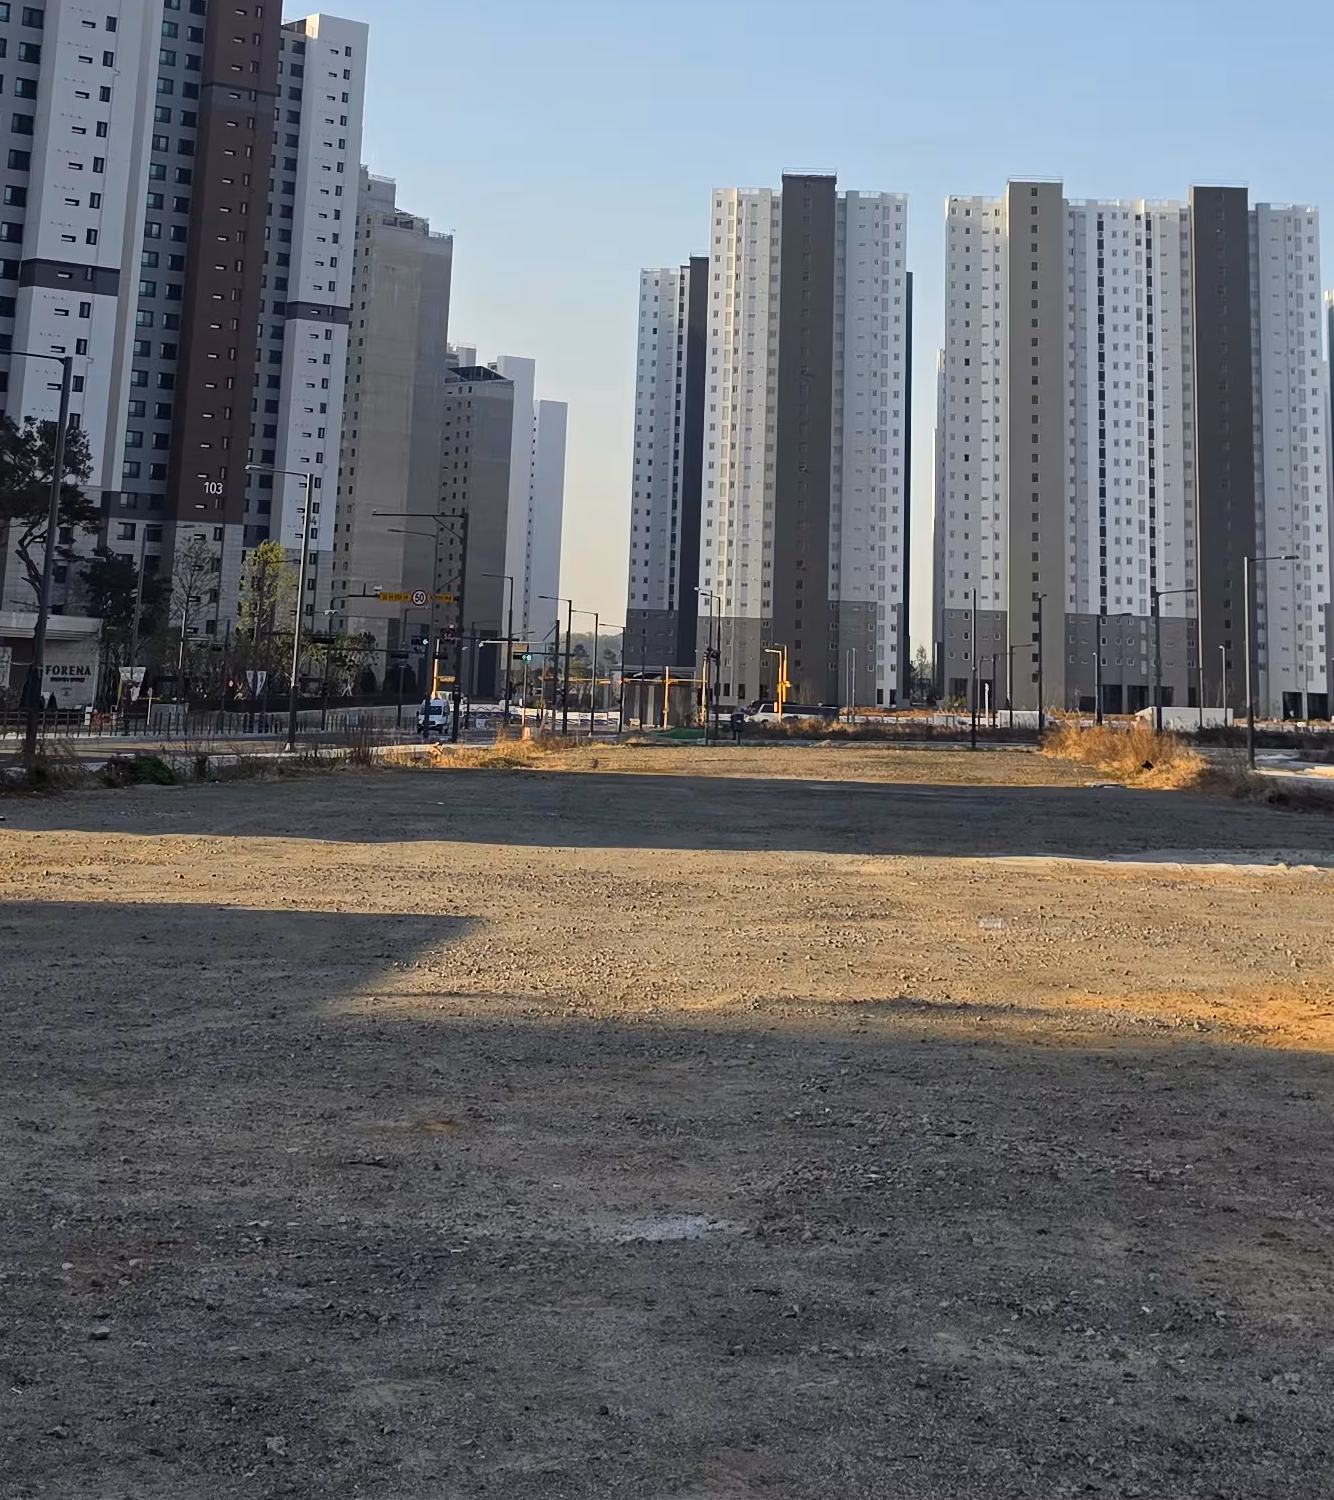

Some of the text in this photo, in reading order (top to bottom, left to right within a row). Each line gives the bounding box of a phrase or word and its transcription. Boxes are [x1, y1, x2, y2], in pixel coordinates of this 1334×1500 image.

[203, 481, 223, 495] 103
[301, 514, 318, 526] 14
[414, 593, 425, 603] 50
[45, 664, 92, 676] FORENA
